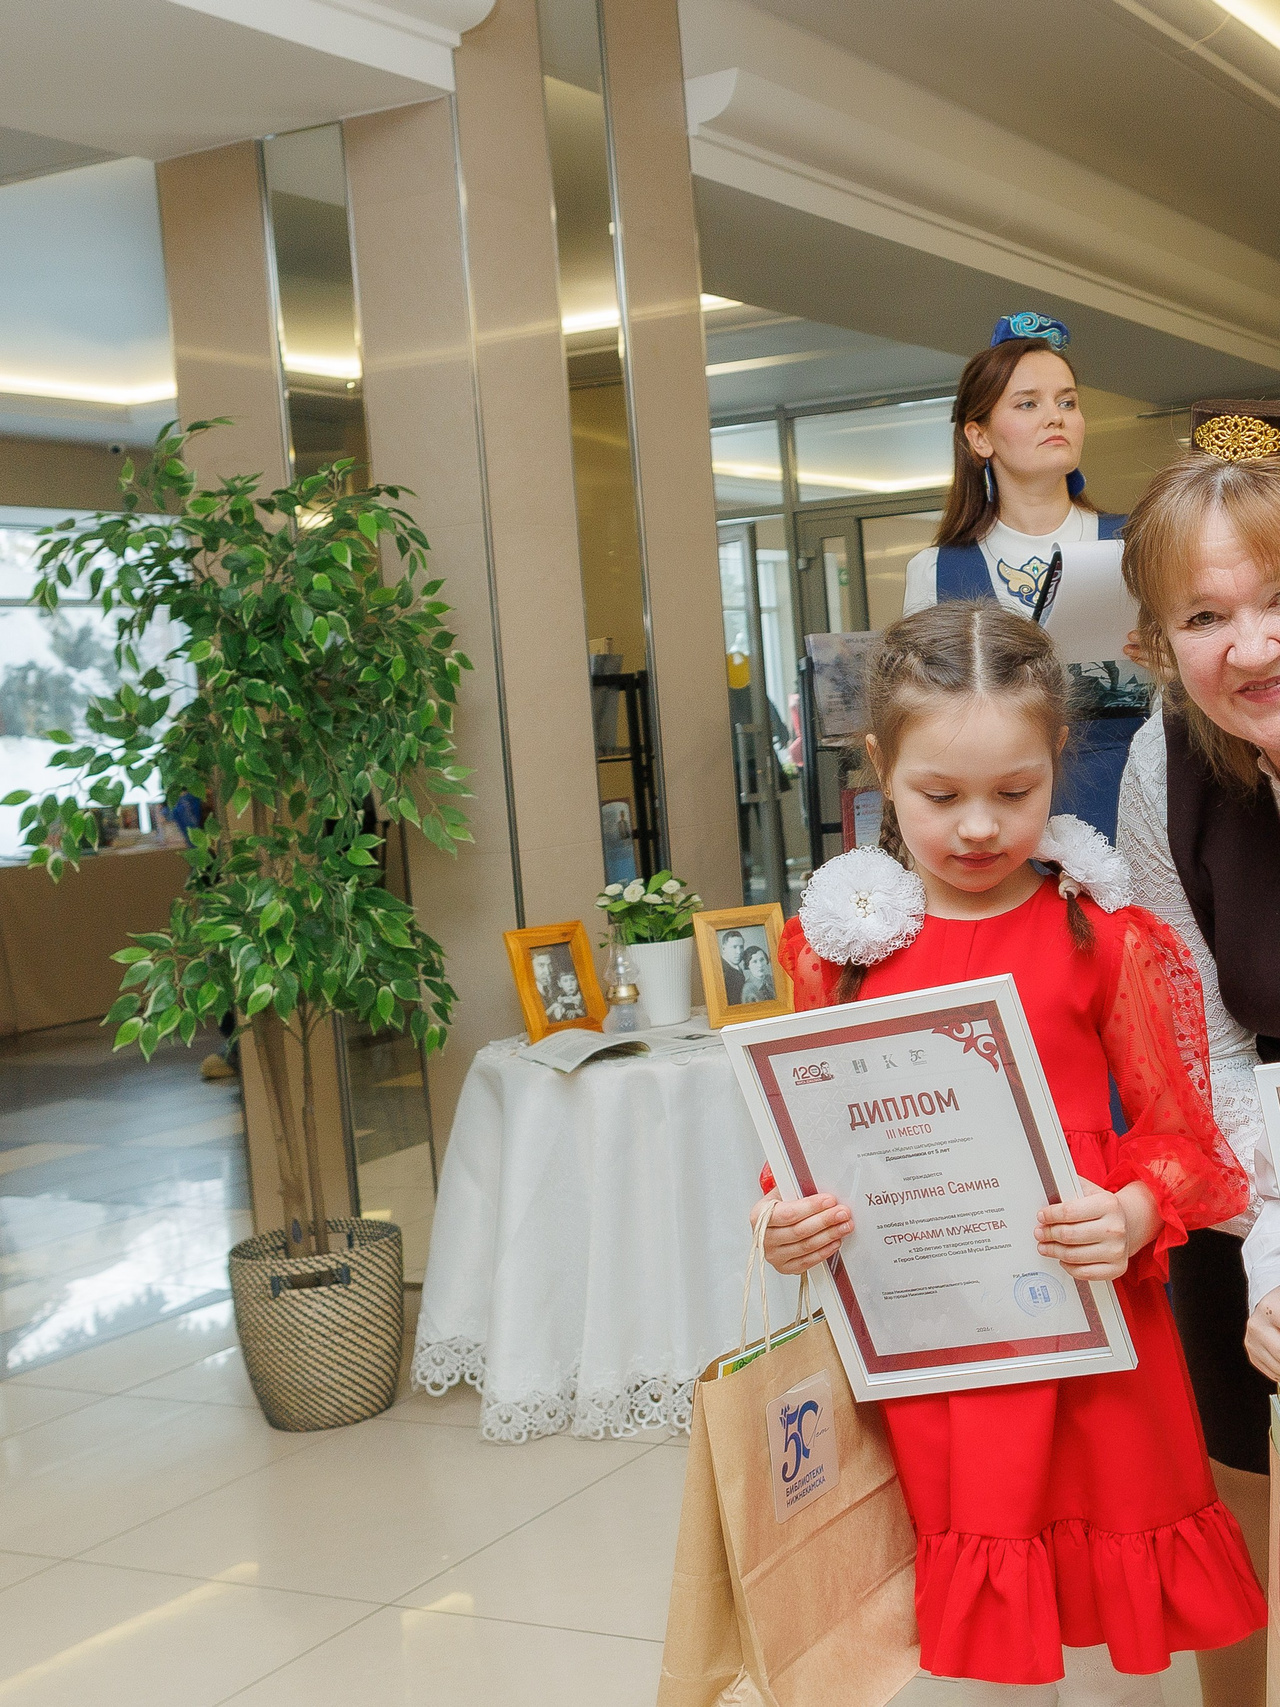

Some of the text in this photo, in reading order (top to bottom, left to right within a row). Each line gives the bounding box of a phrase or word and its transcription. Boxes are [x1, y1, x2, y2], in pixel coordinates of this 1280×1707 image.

[848, 1088, 960, 1131] ДИПЛОМ
[898, 1124, 932, 1138] МЕСТО
[903, 1172, 943, 1182] награждается
[865, 1177, 1000, 1206] Хайруллина Самина
[909, 1214, 956, 1225] Муниципальном
[884, 1220, 1008, 1245] СТРОКАМИ МУЖЕСТВА
[943, 1241, 974, 1249] татарского
[915, 1252, 947, 1260] Советского
[786, 1464, 824, 1497] БИБЛИОТЕКИ
[786, 1475, 825, 1508] НИЖНЕКАМСКА
